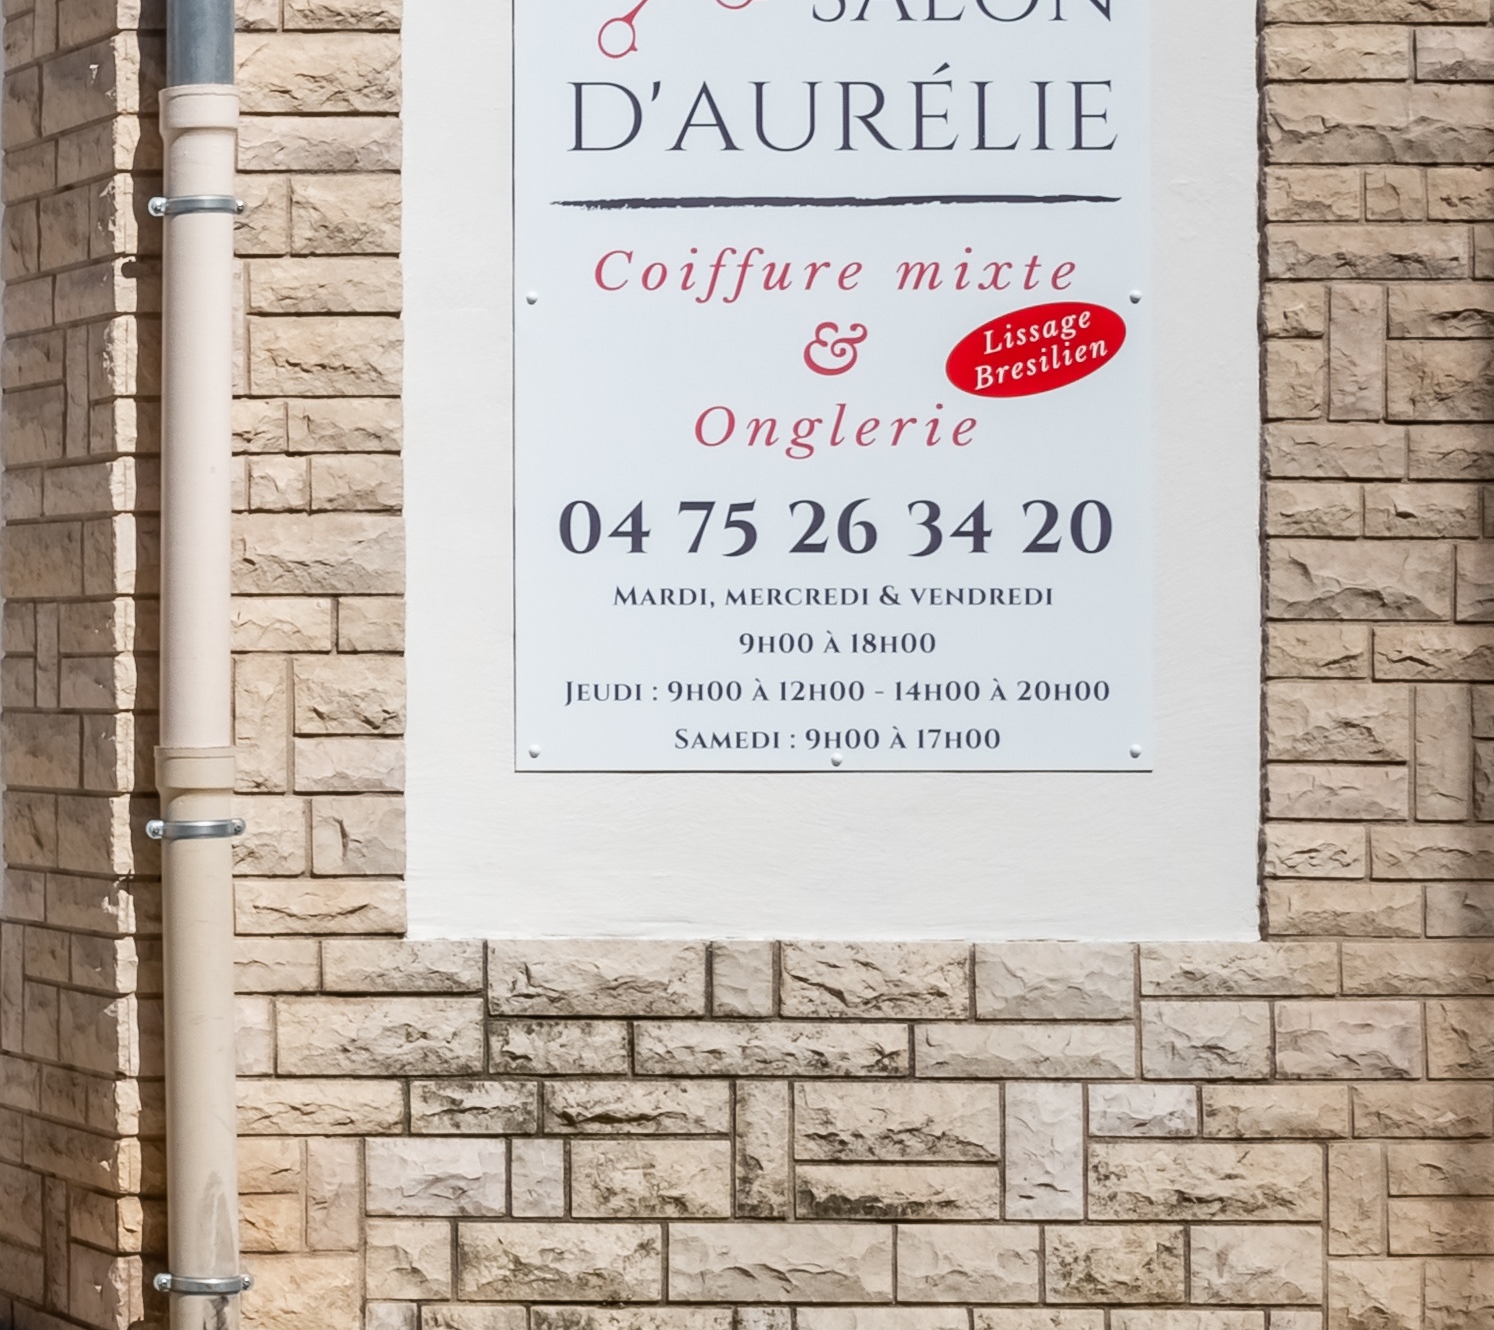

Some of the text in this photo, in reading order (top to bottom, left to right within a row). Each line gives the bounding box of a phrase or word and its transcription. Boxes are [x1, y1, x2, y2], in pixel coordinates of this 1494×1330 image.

[567, 62, 1118, 153] D'AURÉLIE
[594, 247, 1079, 304] Coiffure mixte
[803, 321, 869, 377] &
[983, 310, 1091, 355] Lissage
[974, 339, 1108, 390] Bresilien
[694, 402, 978, 460] Onglerie
[558, 498, 1113, 558] 04 75 26 34 20
[878, 585, 902, 606] &
